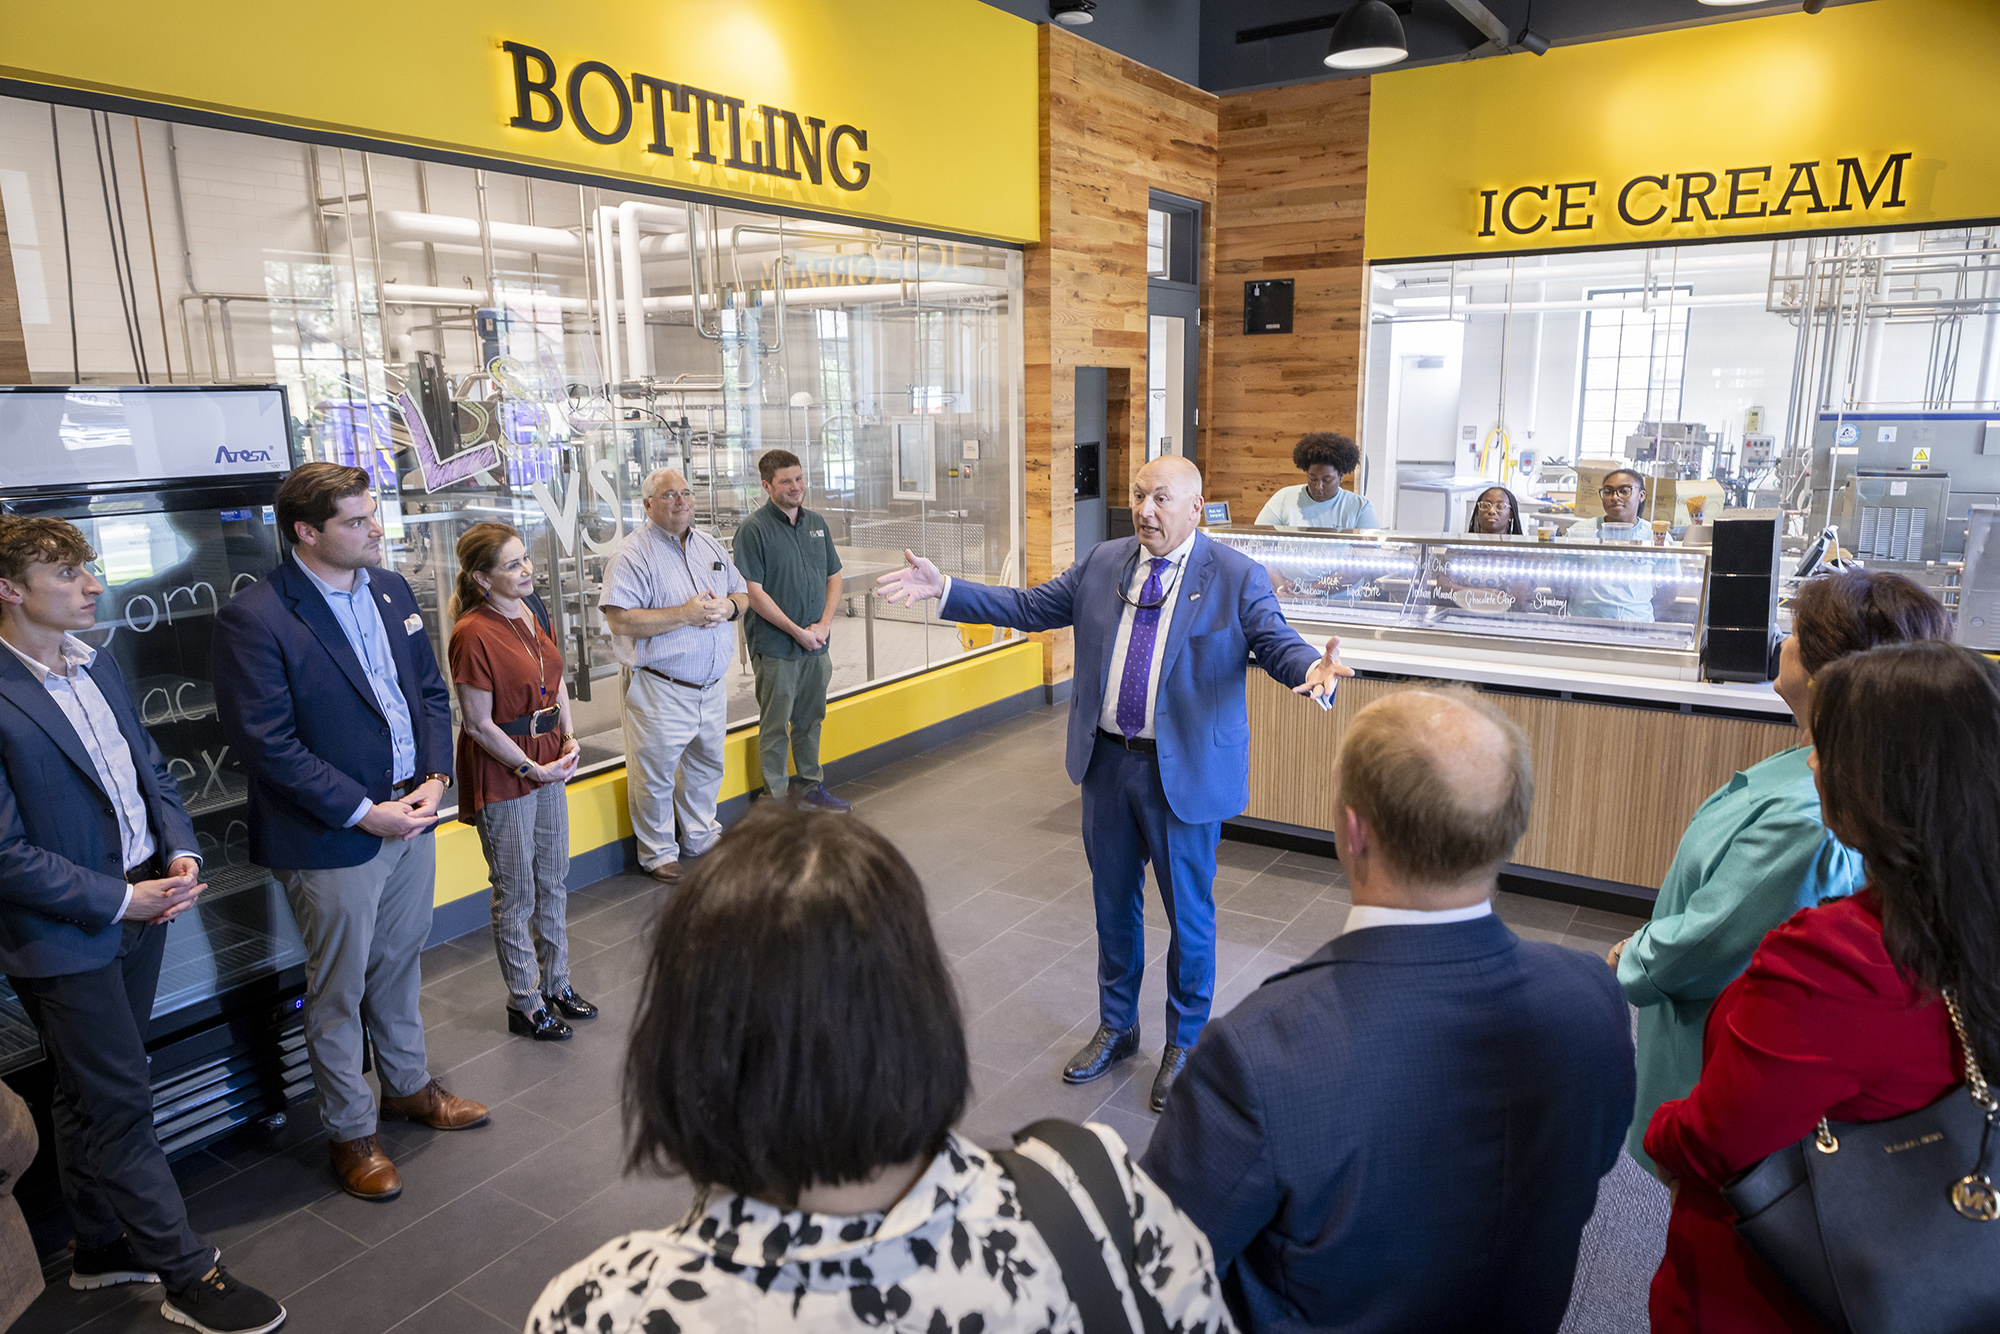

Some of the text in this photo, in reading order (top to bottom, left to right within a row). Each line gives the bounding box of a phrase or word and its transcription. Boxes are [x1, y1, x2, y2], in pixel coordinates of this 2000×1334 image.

[502, 40, 871, 192] BOTTLING
[1477, 152, 1912, 237] ICE CREAM
[214, 445, 271, 463] ATOSA
[1465, 590, 1516, 609] Chocolate Chip
